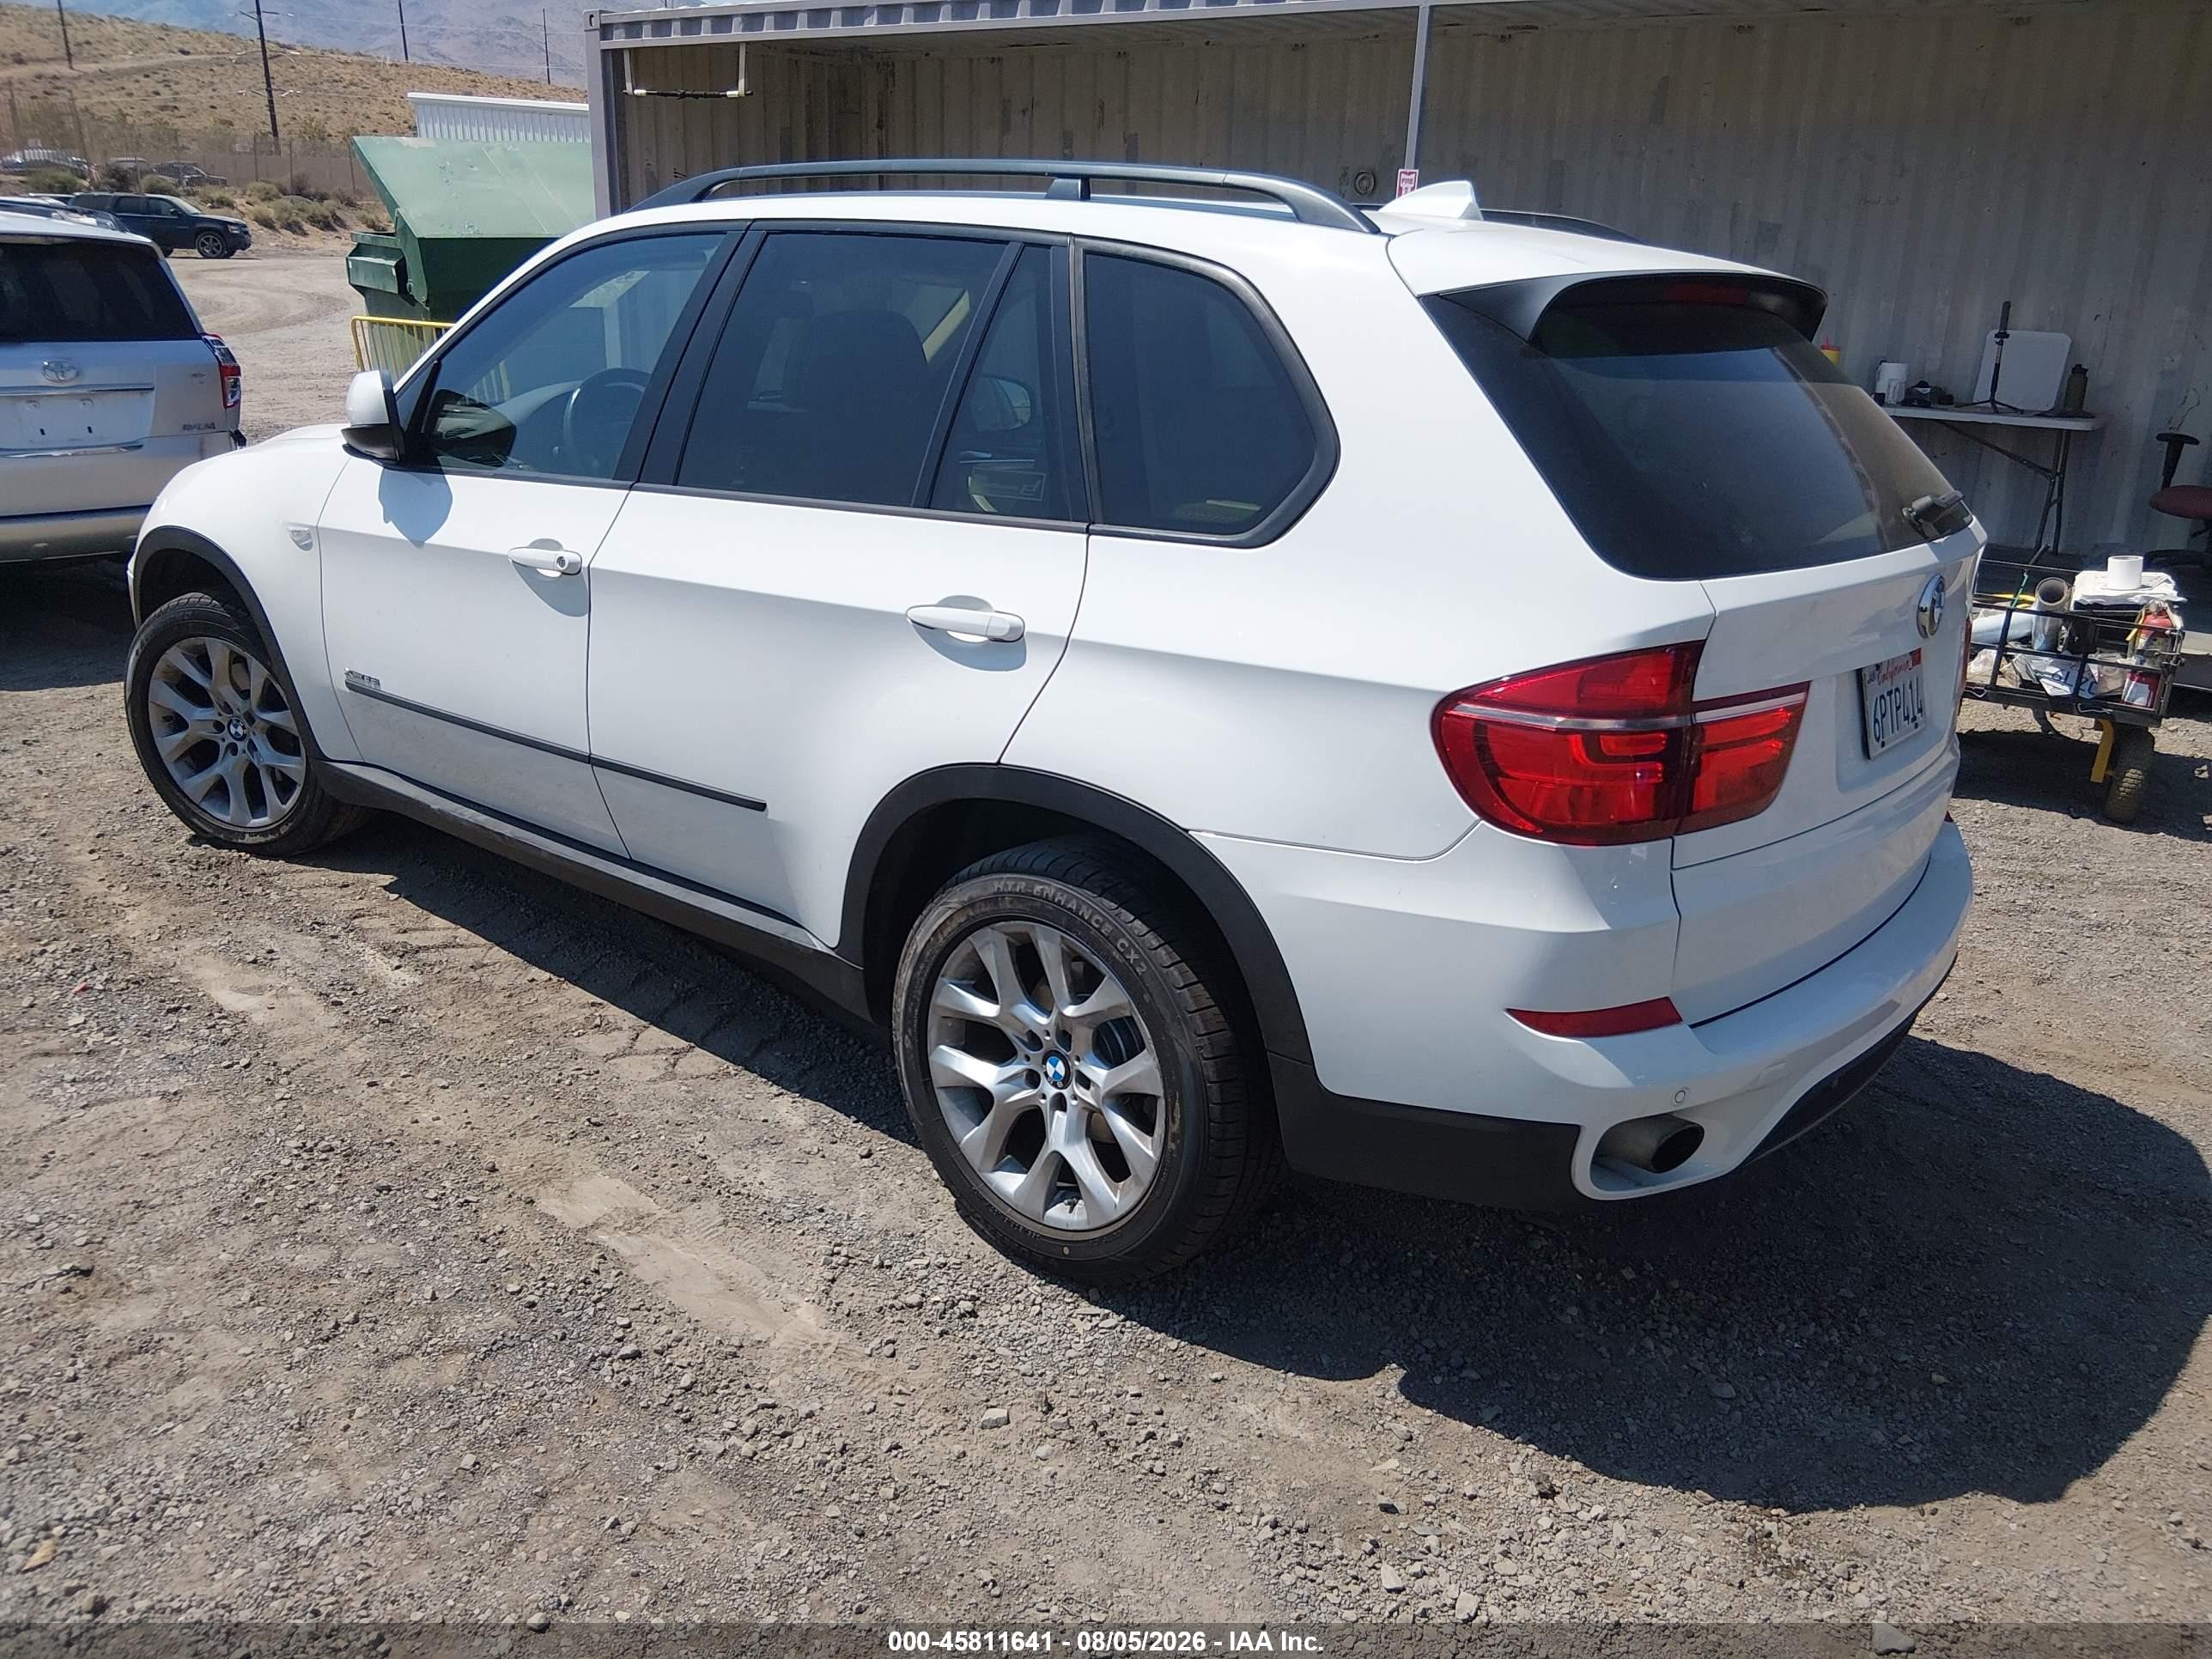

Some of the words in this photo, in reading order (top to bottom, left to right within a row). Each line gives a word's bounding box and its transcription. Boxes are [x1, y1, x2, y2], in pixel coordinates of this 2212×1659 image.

[1873, 676, 1923, 743] 6PTP414
[993, 878, 1027, 894] HTR
[1032, 884, 1114, 938] ENHANCE
[1115, 937, 1148, 976] CX2
